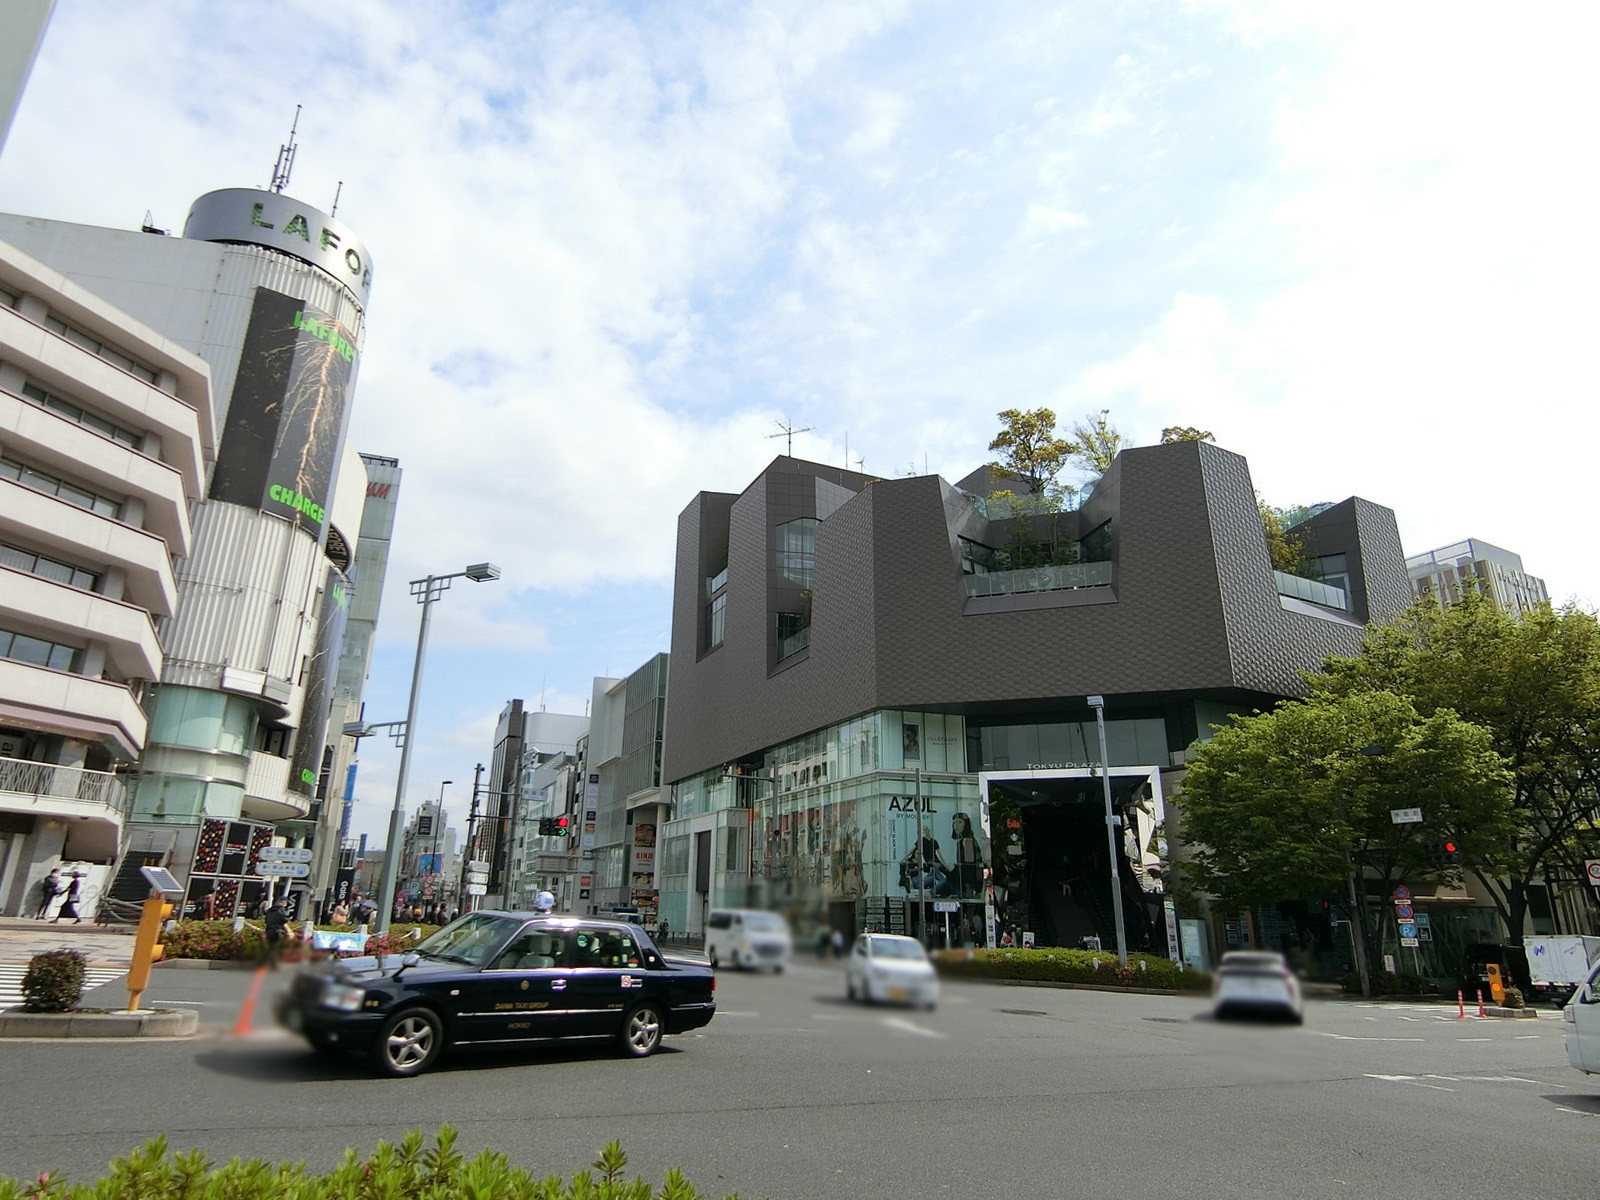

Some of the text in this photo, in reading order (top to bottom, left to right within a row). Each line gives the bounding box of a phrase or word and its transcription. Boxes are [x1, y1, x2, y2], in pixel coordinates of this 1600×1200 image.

[269, 484, 325, 524] CHARGE
[1065, 761, 1102, 769] PLAZA
[888, 796, 937, 814] AZUL
